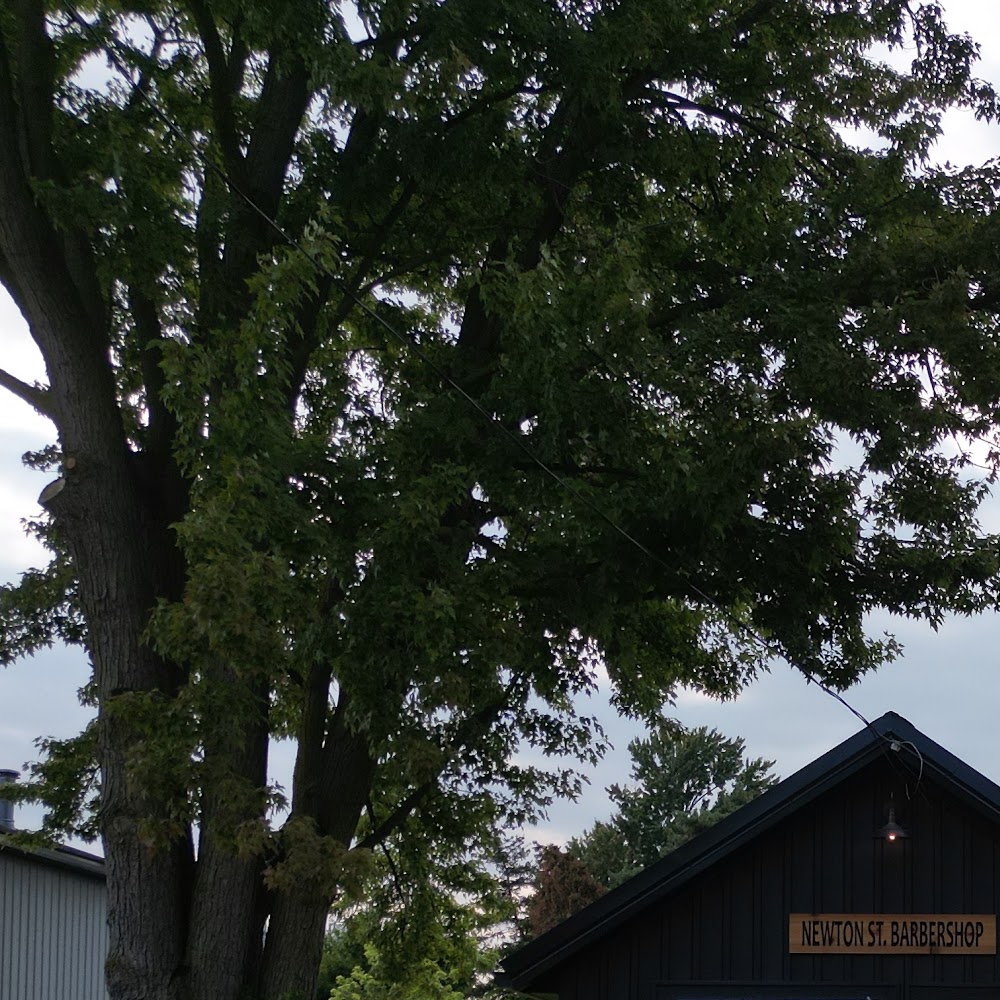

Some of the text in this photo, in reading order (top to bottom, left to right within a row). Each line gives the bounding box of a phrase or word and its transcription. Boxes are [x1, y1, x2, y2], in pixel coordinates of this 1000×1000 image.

[802, 920, 984, 947] NEWTON ST. BARBERSHOP
